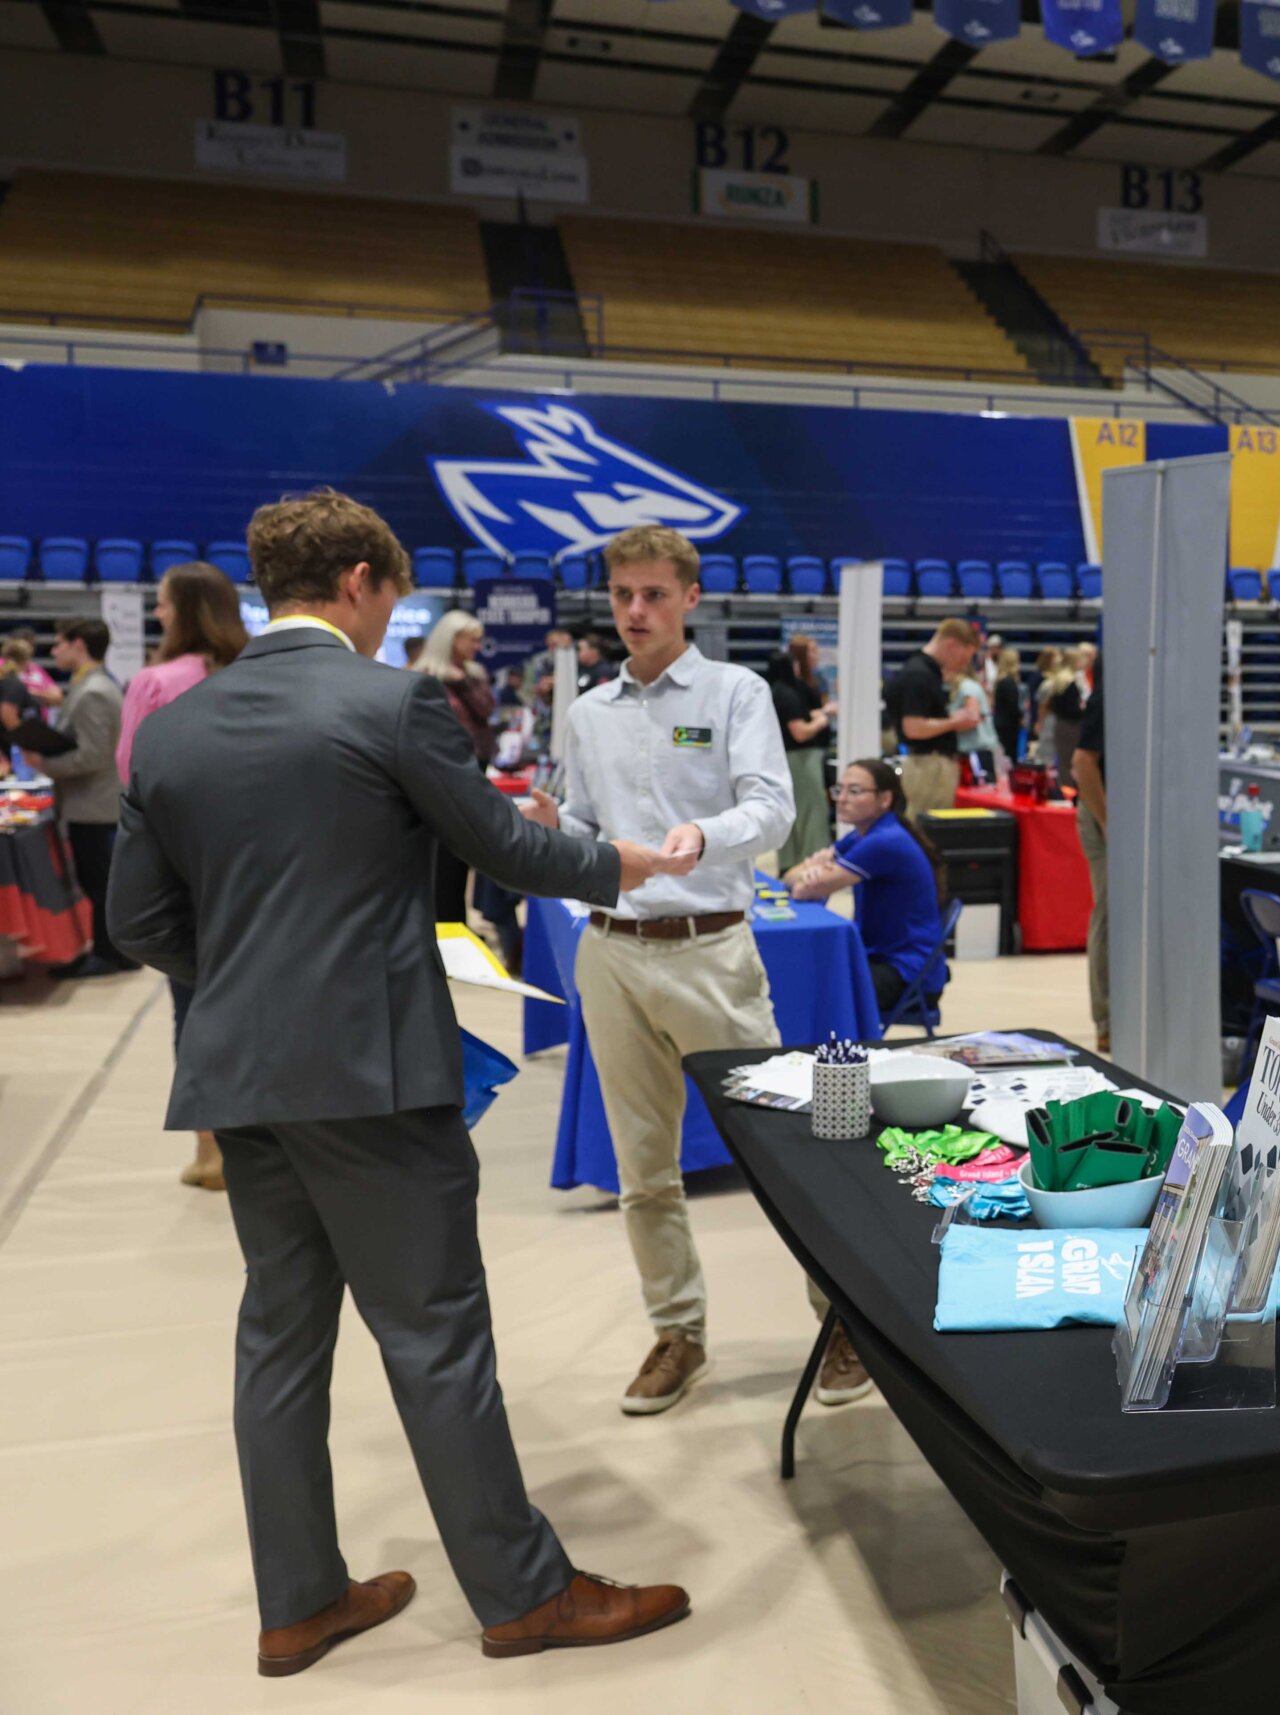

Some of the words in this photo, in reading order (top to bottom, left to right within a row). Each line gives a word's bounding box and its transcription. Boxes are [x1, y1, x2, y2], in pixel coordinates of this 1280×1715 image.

[214, 70, 316, 130] B11
[696, 120, 789, 174] B12
[1121, 163, 1204, 214] B13
[1097, 422, 1137, 448] A12
[1238, 429, 1277, 455] A13
